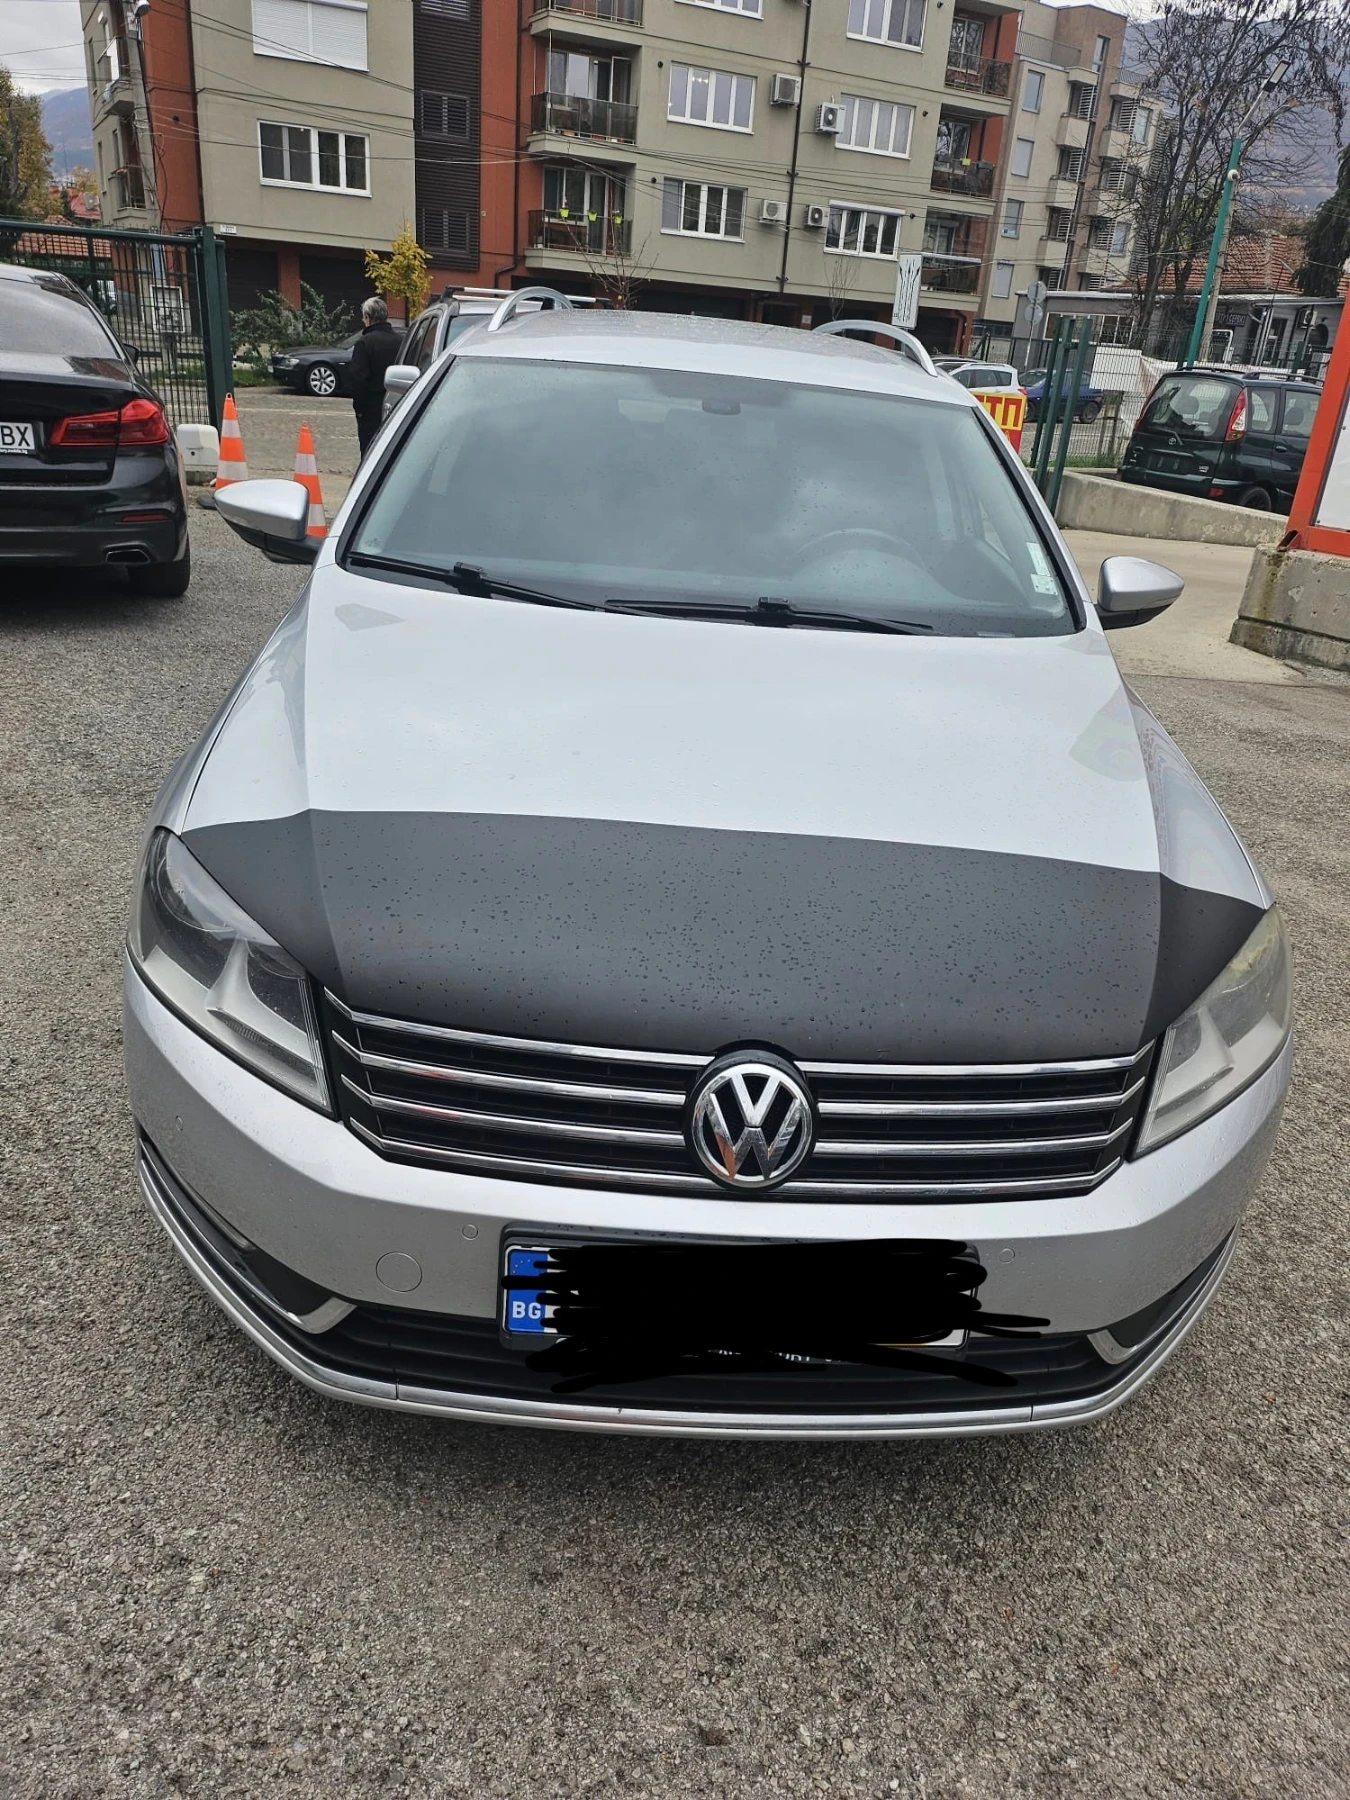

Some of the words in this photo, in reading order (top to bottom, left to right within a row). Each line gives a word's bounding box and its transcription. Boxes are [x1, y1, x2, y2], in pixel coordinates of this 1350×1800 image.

[975, 394, 1023, 428] ТП
[0, 425, 31, 447] BX
[699, 1068, 804, 1184] VW
[512, 1300, 542, 1319] BG
